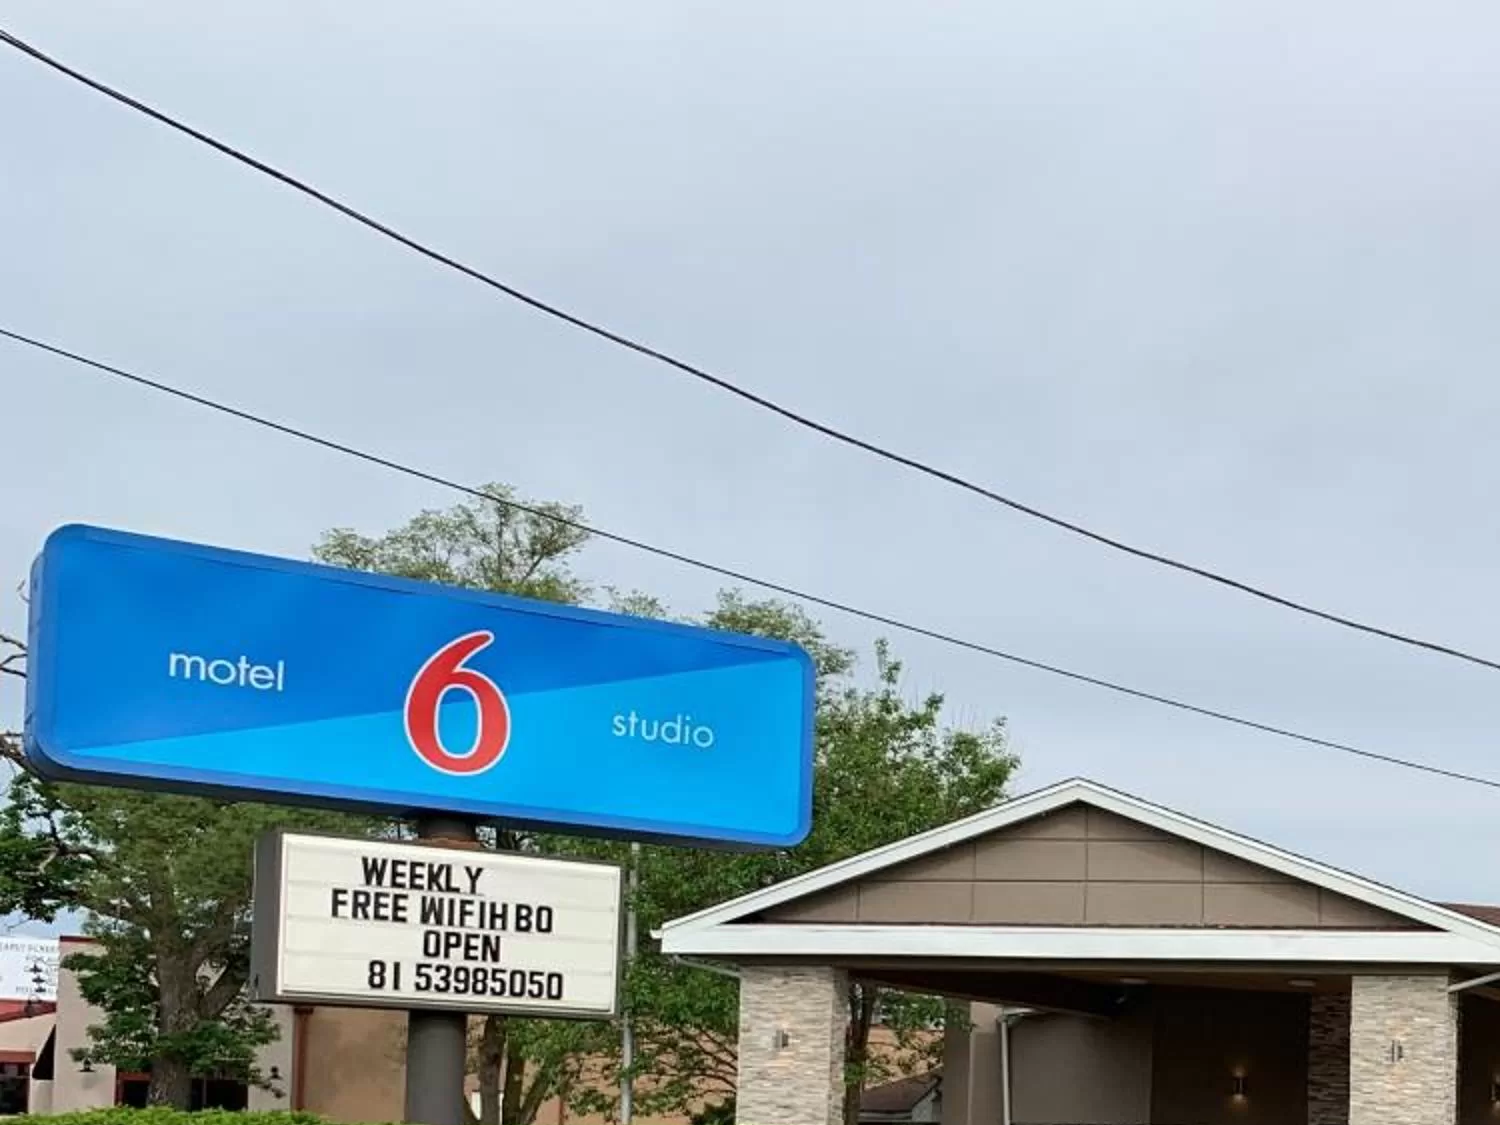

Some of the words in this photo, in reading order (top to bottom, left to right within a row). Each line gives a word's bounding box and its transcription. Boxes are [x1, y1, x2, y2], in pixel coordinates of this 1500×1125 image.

[169, 652, 285, 692] motel
[403, 629, 511, 777] 6
[611, 710, 715, 749] studio
[361, 855, 485, 895] WEEKLY
[331, 888, 409, 924] FREE
[423, 929, 501, 963] OPEN
